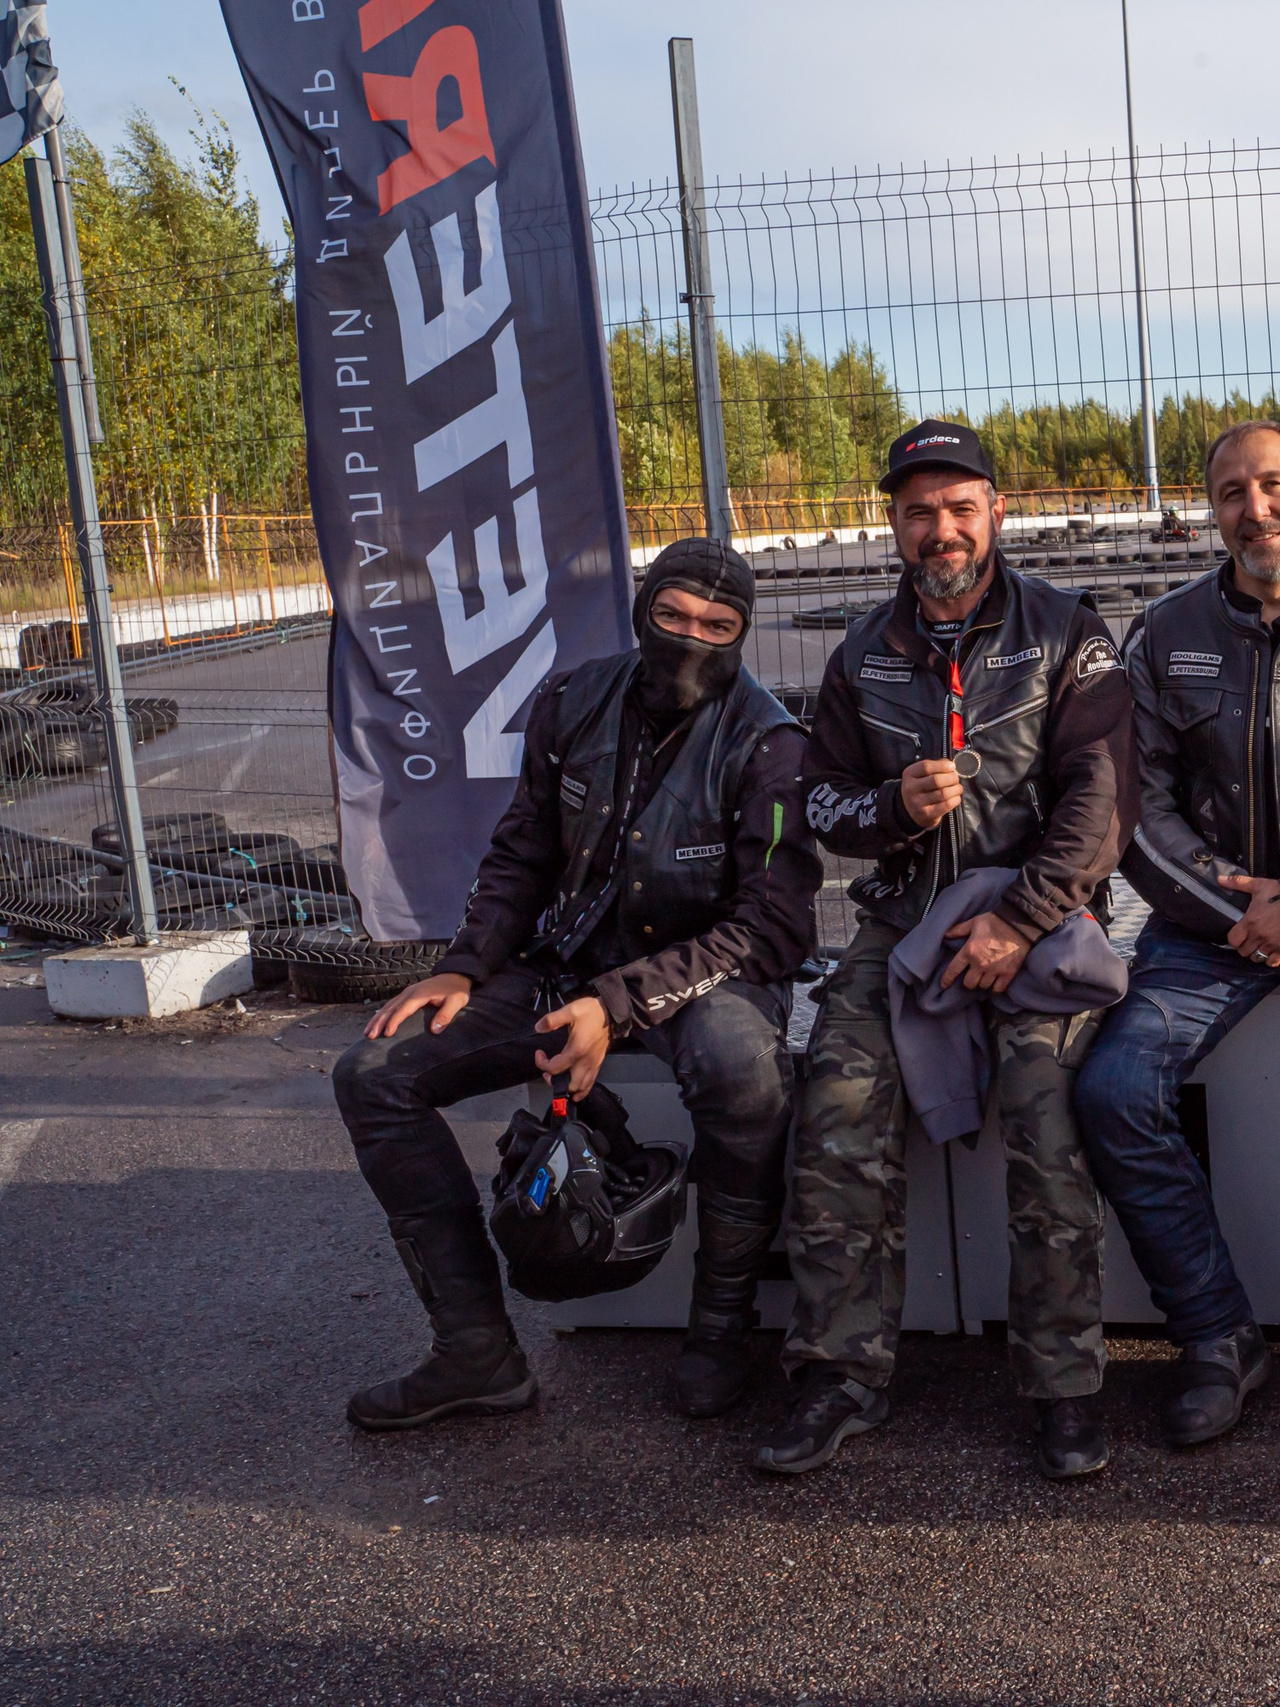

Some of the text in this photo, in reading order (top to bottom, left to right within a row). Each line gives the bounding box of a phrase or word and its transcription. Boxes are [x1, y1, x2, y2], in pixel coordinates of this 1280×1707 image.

[990, 649, 1038, 666] MEMBER
[1171, 653, 1220, 663] HOOLIGANS
[678, 846, 723, 858] MEMBER
